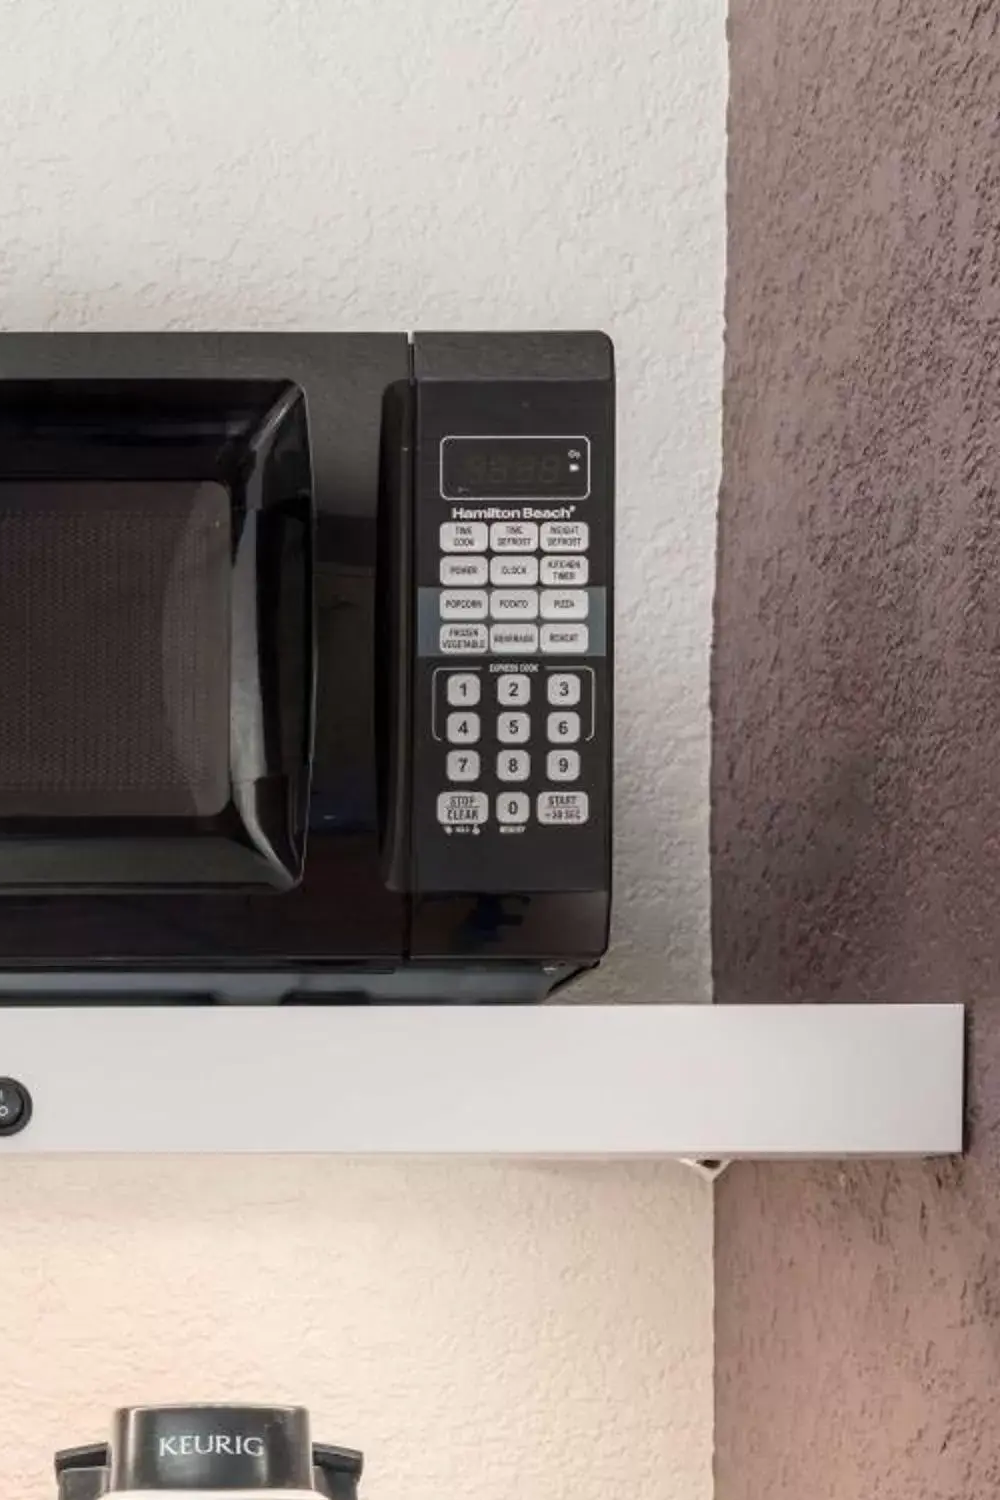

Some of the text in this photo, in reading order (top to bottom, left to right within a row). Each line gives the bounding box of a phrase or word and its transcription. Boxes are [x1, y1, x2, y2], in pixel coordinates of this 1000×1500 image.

[452, 507, 521, 519] Hamilton
[455, 526, 472, 534] TIME
[506, 526, 523, 534] TIME
[550, 526, 578, 534] WEIGHT
[498, 538, 532, 546] DEFROST
[547, 538, 582, 546] DEFROST
[548, 560, 580, 568] KITCHEN
[501, 566, 526, 574] CLOCK
[553, 571, 575, 579] TIMER
[445, 600, 482, 609] POPCORN
[499, 600, 529, 609] POTATO
[554, 600, 575, 609] PIZZA
[442, 640, 485, 648] VEGETABLE
[459, 682, 468, 697] 1
[508, 682, 519, 697] 2
[559, 682, 569, 697] 3
[457, 721, 468, 735] 4
[509, 720, 519, 735] 5
[558, 721, 568, 735] 6
[458, 758, 468, 772] 7
[508, 758, 518, 773] 8
[559, 758, 568, 773] 9
[450, 796, 474, 806] STOP
[548, 796, 577, 804] START
[508, 801, 518, 814] 0
[447, 809, 478, 820] CLEAR
[159, 1435, 264, 1457] KEURIG
